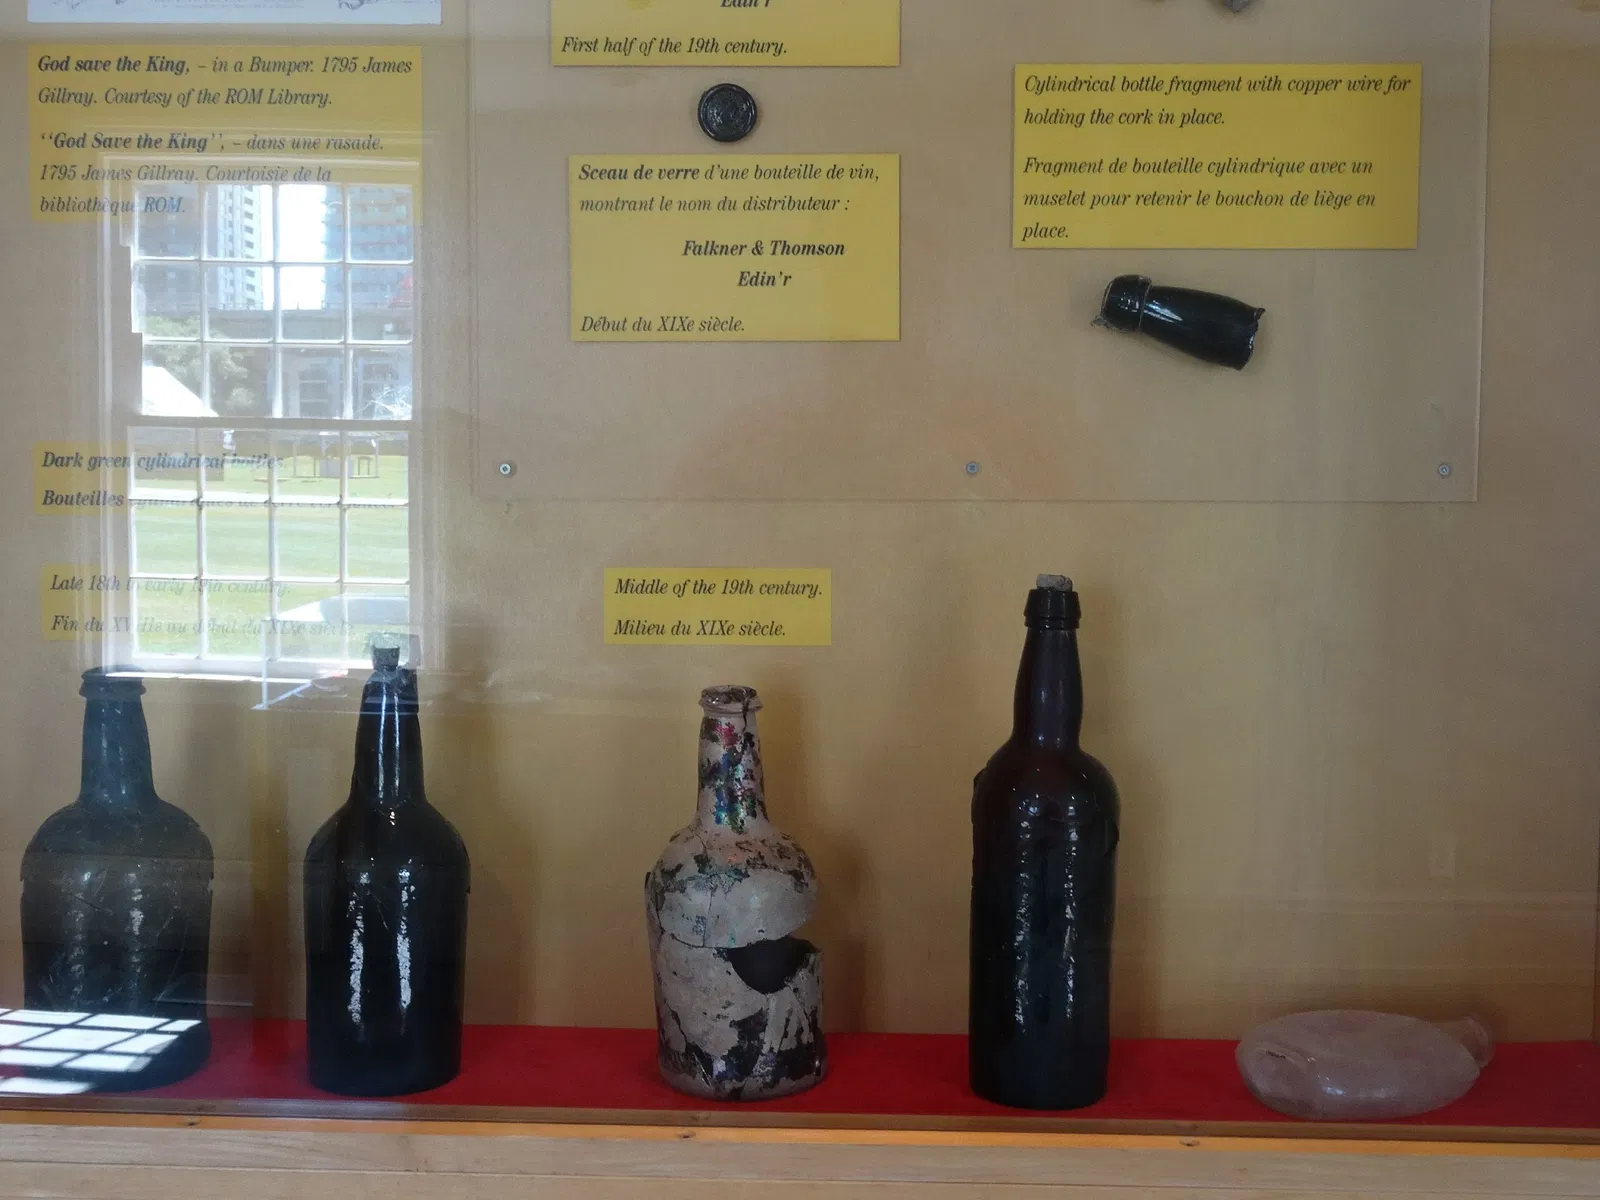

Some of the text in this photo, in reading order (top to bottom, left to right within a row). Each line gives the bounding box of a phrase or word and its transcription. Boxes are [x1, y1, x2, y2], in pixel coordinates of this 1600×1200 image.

[562, 36, 787, 57] First half of the 19th century.
[38, 55, 71, 72] God
[75, 58, 111, 72] save
[116, 56, 142, 72] the
[146, 56, 190, 75] King,
[212, 56, 229, 72] in
[234, 60, 244, 72] a
[248, 56, 314, 76] Bumper.
[321, 56, 359, 73] 1795
[362, 57, 412, 73] James
[1024, 74, 1411, 96] Cylindrical bottle fragment with copper wire for
[38, 87, 332, 108] Gillray. Courtesy of the ROM Library.
[1024, 108, 1225, 129] holding the cork in place.
[91, 132, 132, 149] Save
[136, 133, 163, 149] the
[247, 134, 286, 150] dans
[291, 137, 321, 150] une
[326, 134, 384, 151] rasade.
[40, 164, 332, 184] 1795 James Gillray. Courtoisie de la
[578, 164, 628, 180] Sceau
[634, 165, 653, 180] de
[659, 168, 699, 180] verre
[754, 164, 821, 180] bouteille
[826, 164, 844, 180] de
[849, 164, 879, 182] vin,
[1022, 157, 1373, 177] Fragment de bouteille cylindrique avec un
[40, 196, 186, 216] bibliothèque ROM.
[580, 196, 655, 212] montrant
[660, 196, 673, 212] le
[677, 199, 711, 212] nom
[717, 196, 737, 212] du
[743, 195, 840, 211] distributeur
[1023, 190, 1375, 210] muselet pour retenir le bouchon de liège en
[1021, 222, 1069, 242] place.
[682, 240, 845, 256] Falkner & Thomson
[580, 316, 745, 332] Début du XIXe siècle.
[42, 452, 82, 468] Dark
[88, 456, 131, 471] green
[43, 490, 124, 506] Bouteilles
[51, 575, 84, 591] Late
[614, 578, 822, 598] Middle of the 19th century.
[50, 615, 79, 631] Fin
[85, 616, 103, 631] du
[614, 619, 786, 636] Milieu du XIXe siècle.
